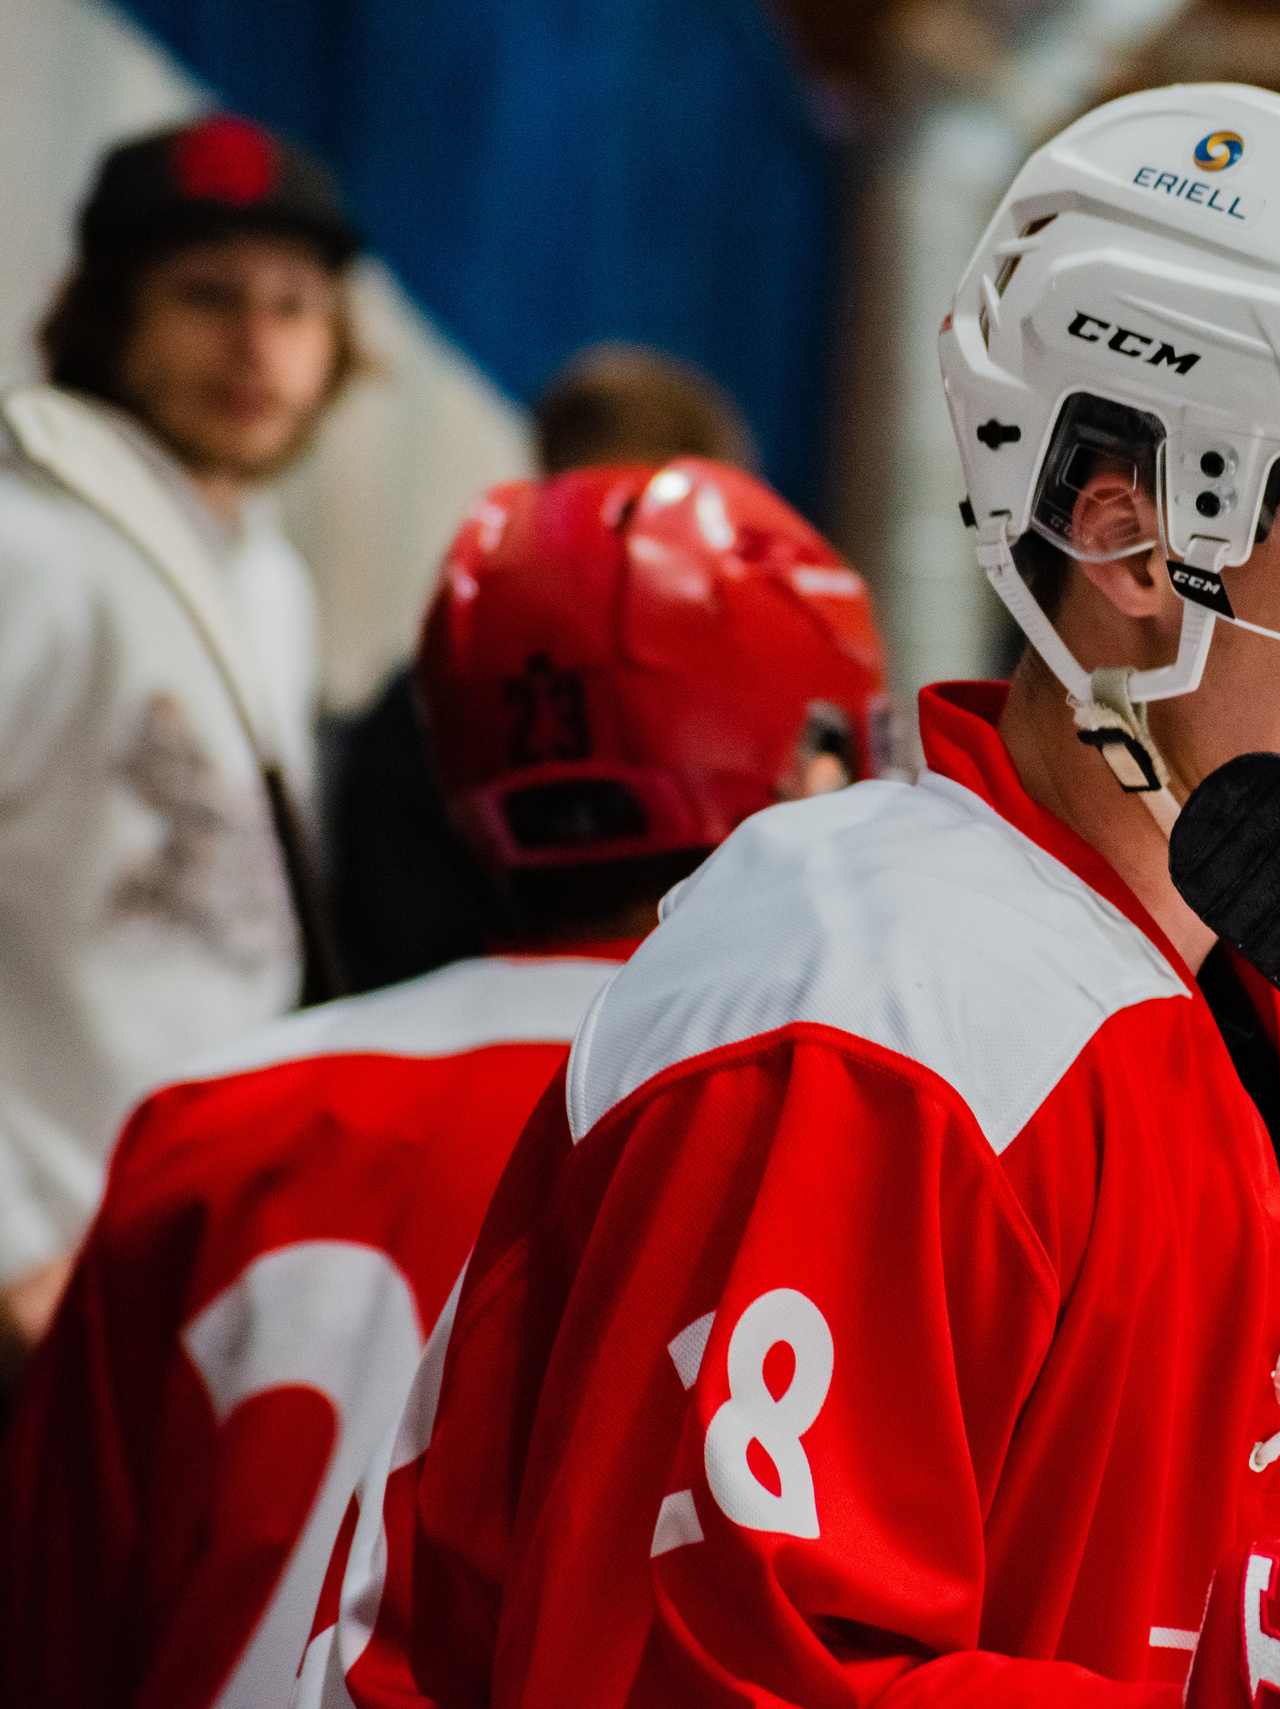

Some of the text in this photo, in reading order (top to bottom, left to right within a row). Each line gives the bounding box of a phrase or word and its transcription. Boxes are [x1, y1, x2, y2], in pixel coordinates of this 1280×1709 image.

[1133, 166, 1247, 221] ERIELL
[1067, 310, 1202, 375] CCM
[1172, 569, 1221, 595] CCM
